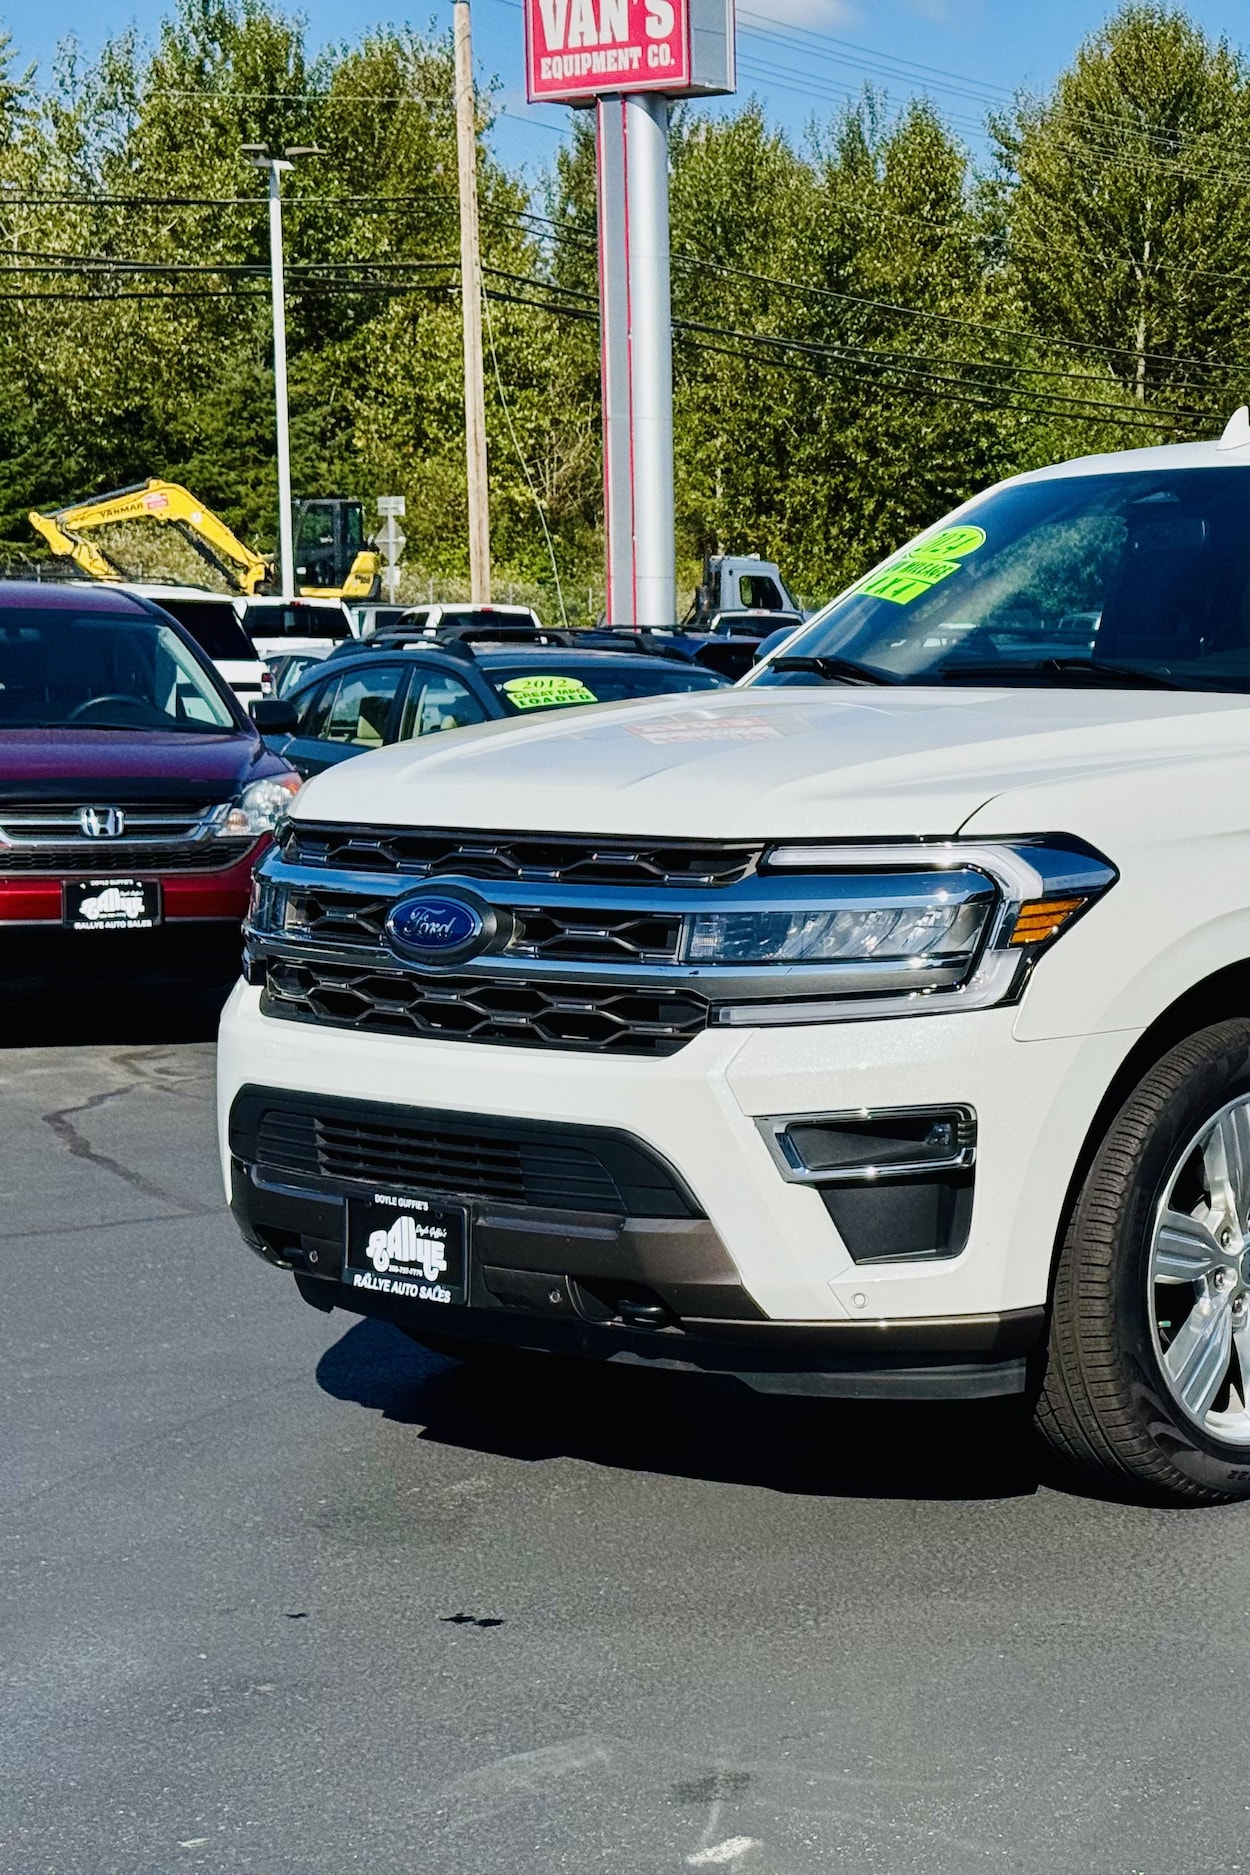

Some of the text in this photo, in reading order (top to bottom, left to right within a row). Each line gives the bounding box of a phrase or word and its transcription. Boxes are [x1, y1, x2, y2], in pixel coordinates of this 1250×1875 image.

[538, 0, 675, 52] VAN'S
[540, 43, 676, 80] EQUIPMENT CO.
[513, 690, 552, 699] GREAT
[519, 694, 590, 705] LOADED
[523, 680, 566, 689] 2012
[403, 906, 458, 938] Ford
[353, 1273, 452, 1304] RALLYE AUTO SALES
